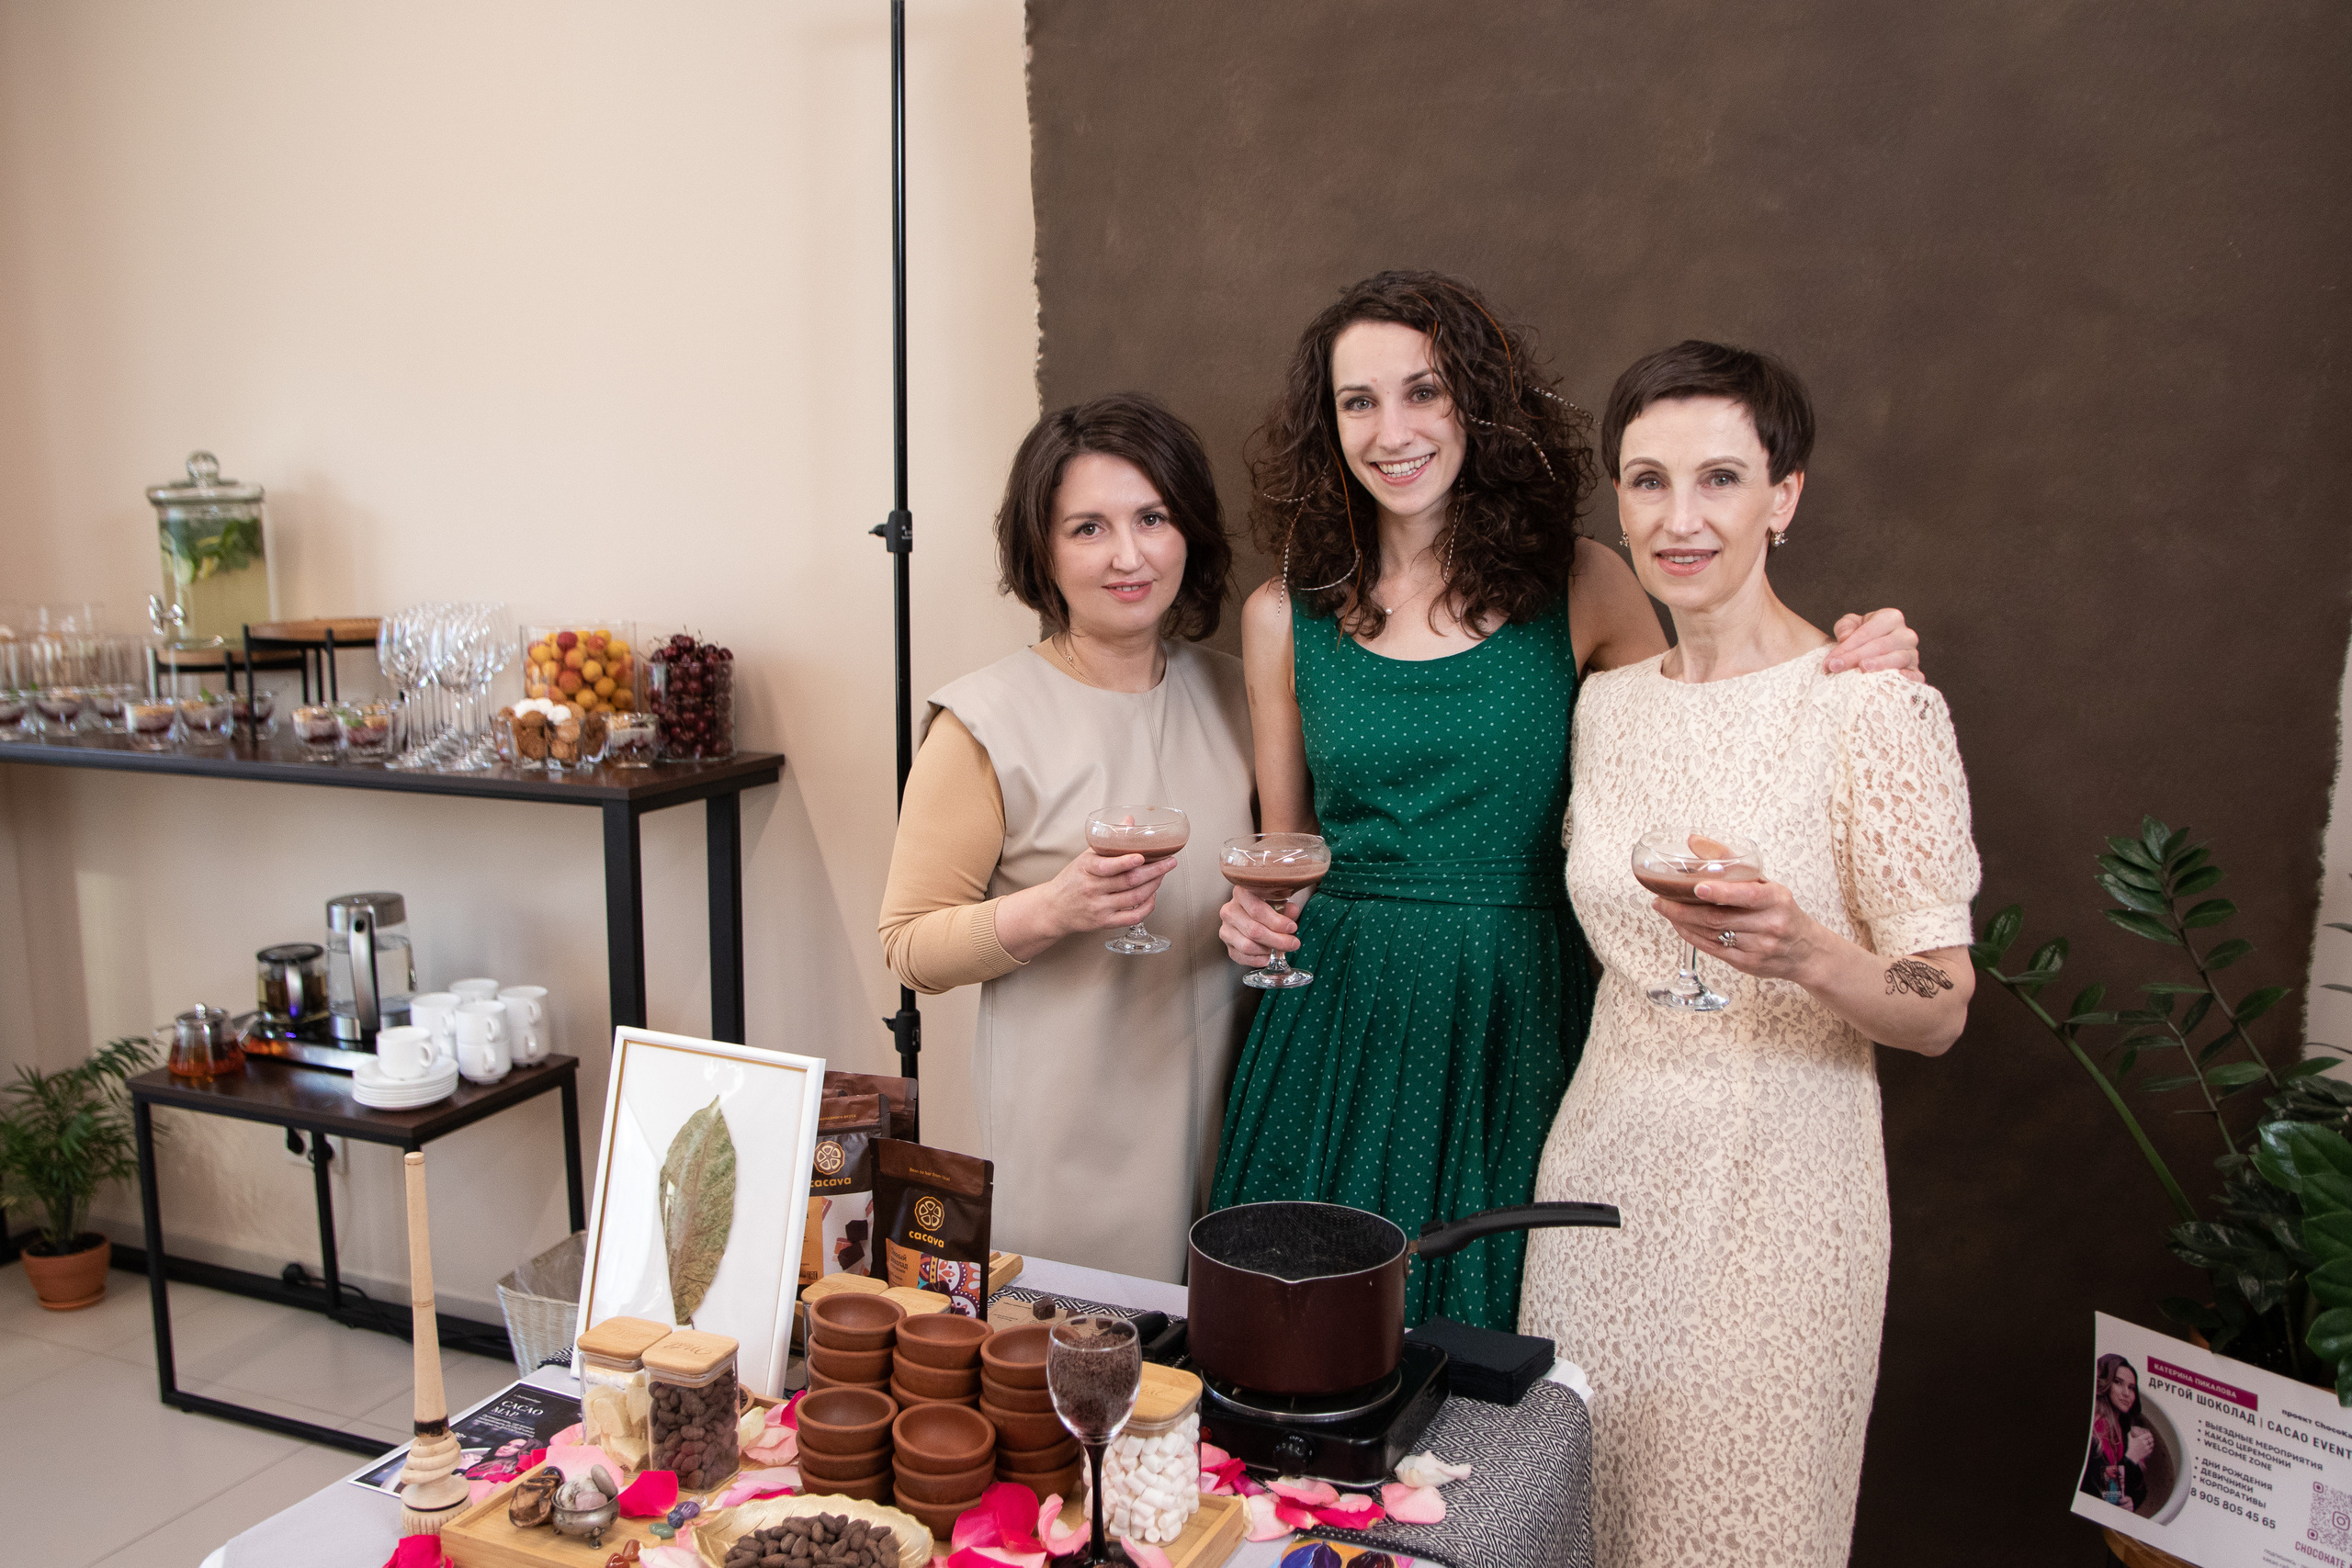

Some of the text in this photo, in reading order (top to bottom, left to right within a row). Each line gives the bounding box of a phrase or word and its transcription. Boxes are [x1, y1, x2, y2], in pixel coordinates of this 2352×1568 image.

[909, 1229, 944, 1248] cacava
[2154, 1362, 2237, 1398] КАТЕРИНА ПИКАЛОВА
[491, 1405, 520, 1417] MAP
[501, 1400, 544, 1416] CACAO
[2149, 1377, 2352, 1460] ДРУГОЙ ШОКОЛАД CACAO EVENT
[2281, 1409, 2312, 1424] проект
[2203, 1438, 2273, 1472] WELCOME ZONE
[2204, 1429, 2291, 1469] КАКАО ЦЕРЕМОНИИ
[2205, 1420, 2324, 1471] ВЫЕЗДНЫЕ МЕРОПРИЯТИЯ
[2200, 1467, 2254, 1493] ДЕВИЧНИКИ
[2201, 1458, 2273, 1491] ДНИ РОЖДЕНИЯ
[2189, 1487, 2277, 1529] 8 905 805 45 65
[2199, 1476, 2267, 1508] КОРПОРАТИВЫ
[2294, 1540, 2346, 1568] CHOCOKATE
